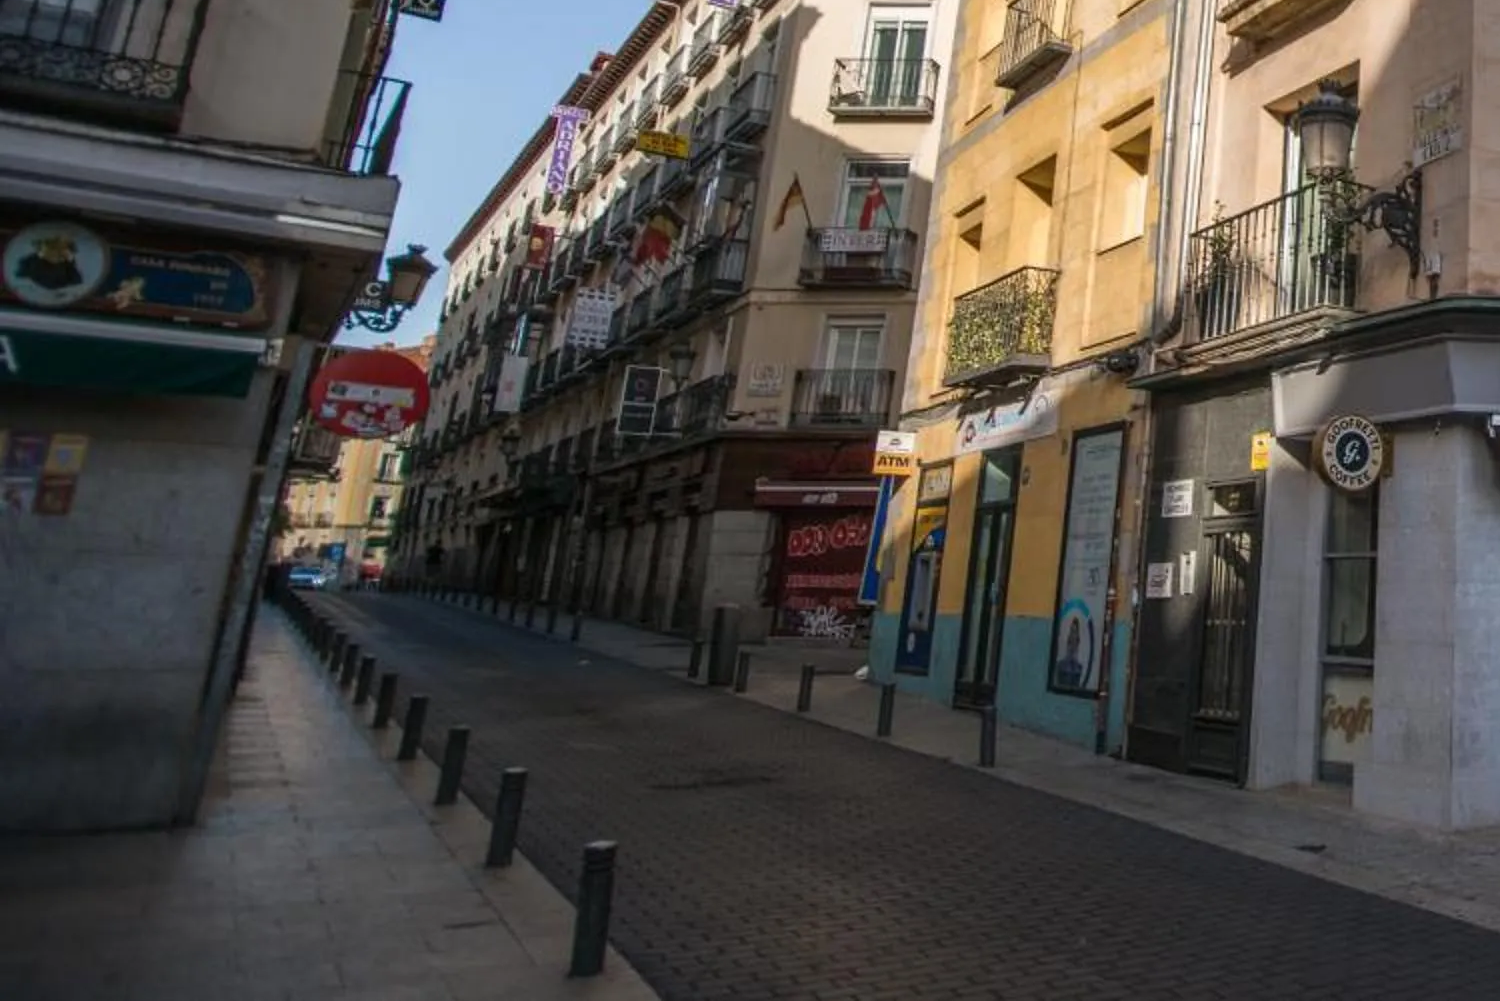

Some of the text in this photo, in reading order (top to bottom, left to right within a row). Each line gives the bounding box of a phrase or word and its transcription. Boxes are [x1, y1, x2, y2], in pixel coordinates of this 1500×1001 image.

[546, 118, 577, 195] ADRIANO
[1327, 417, 1381, 451] GOOFRETTI
[876, 454, 911, 468] ATM
[1329, 463, 1372, 487] COFFEE
